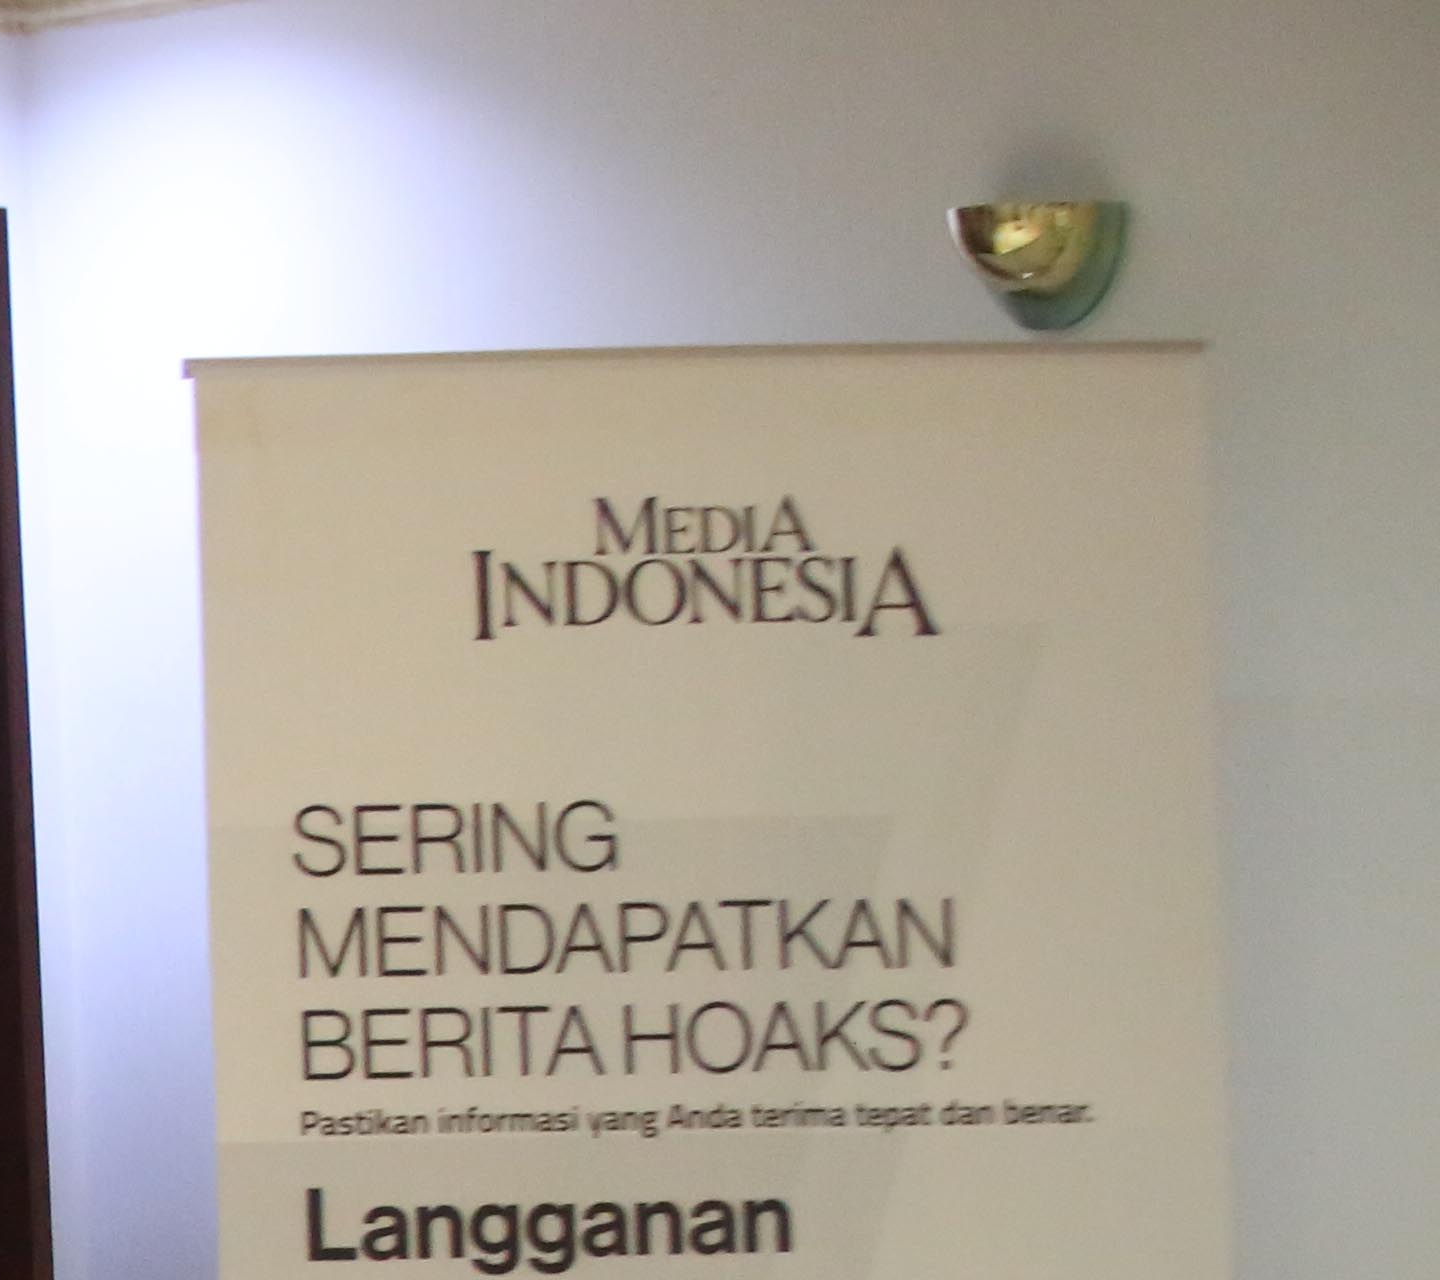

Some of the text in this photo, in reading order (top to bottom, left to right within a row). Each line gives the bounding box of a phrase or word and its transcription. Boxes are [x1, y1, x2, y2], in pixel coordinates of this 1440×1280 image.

[470, 494, 941, 642] MEDIA INDONESIA
[292, 799, 620, 878] SERING
[297, 896, 958, 980] MENDAPATKAN
[301, 996, 970, 1082] BERITA HOAKS?
[299, 1106, 430, 1138] Pastikan
[437, 1104, 581, 1136] informasi
[588, 1107, 661, 1140] yang
[668, 1102, 743, 1130] Anda
[750, 1100, 847, 1130] terima
[854, 1099, 933, 1134] tepat
[940, 1097, 994, 1127] dan
[304, 1186, 795, 1276] Langganan
